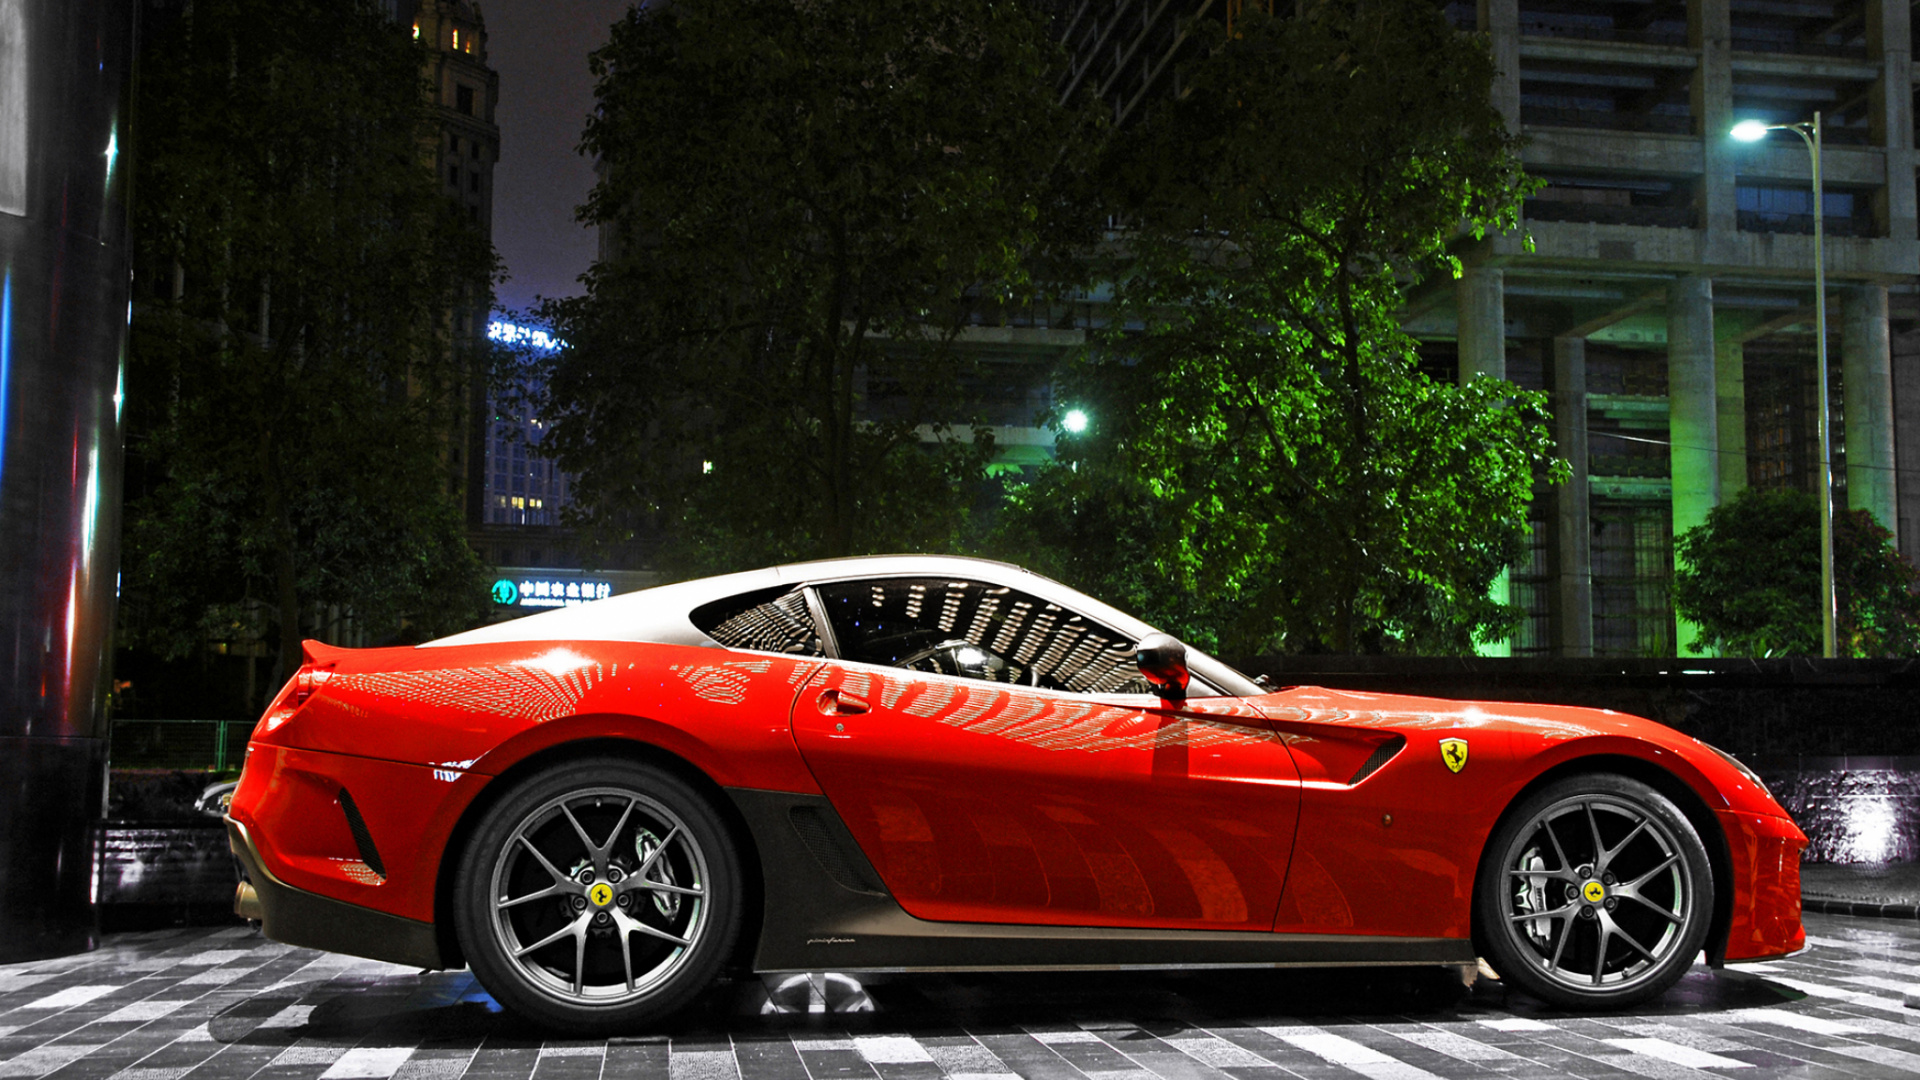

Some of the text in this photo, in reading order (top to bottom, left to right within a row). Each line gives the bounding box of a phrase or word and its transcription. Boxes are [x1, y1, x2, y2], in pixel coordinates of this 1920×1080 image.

[519, 580, 611, 599] 中国农业银行
